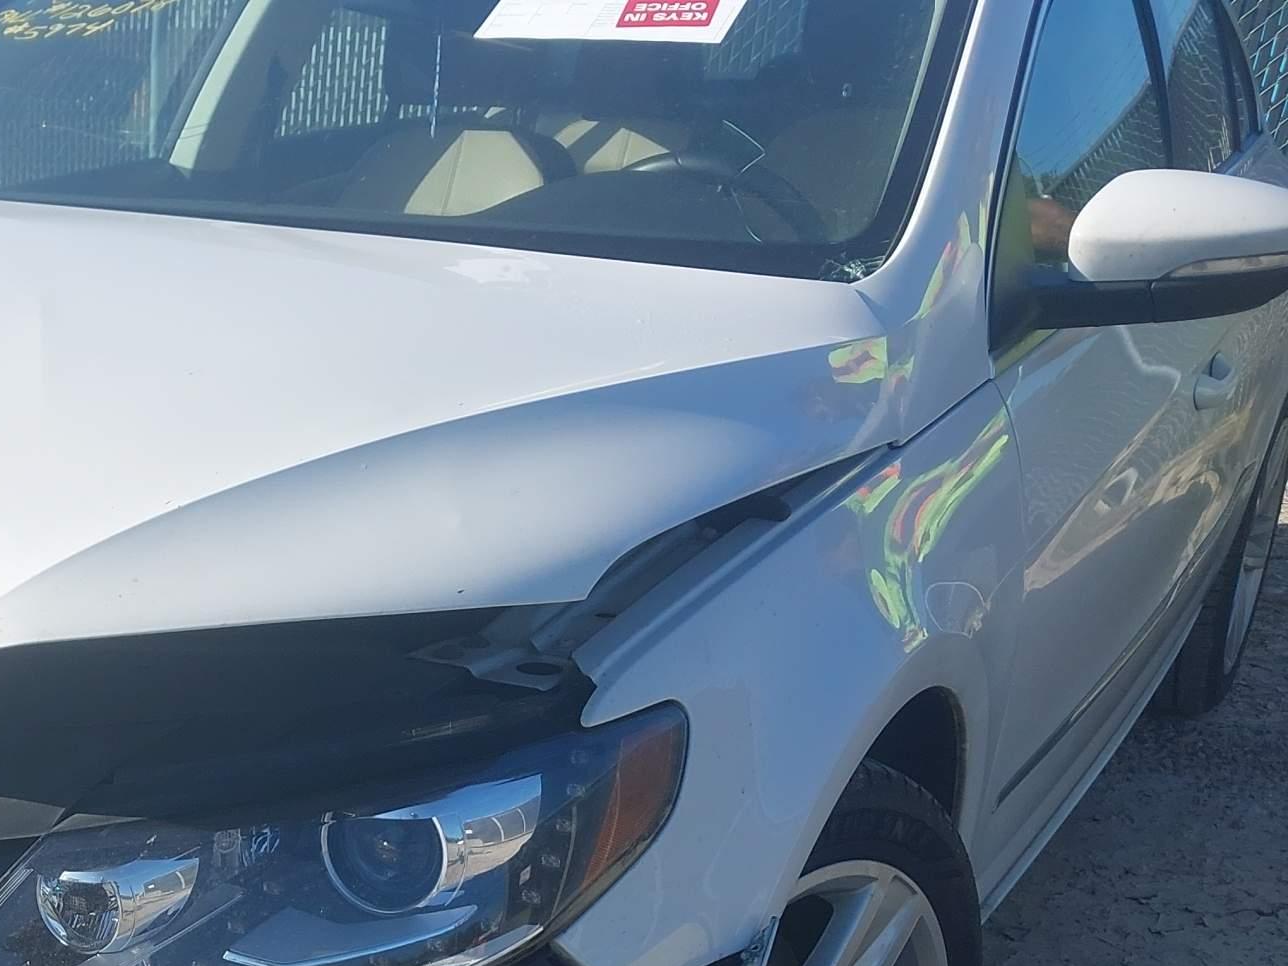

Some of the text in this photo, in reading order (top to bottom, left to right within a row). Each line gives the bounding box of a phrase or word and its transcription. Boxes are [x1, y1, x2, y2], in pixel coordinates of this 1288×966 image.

[634, 2, 707, 12] OFFICE
[623, 12, 709, 22] KEYS IN
